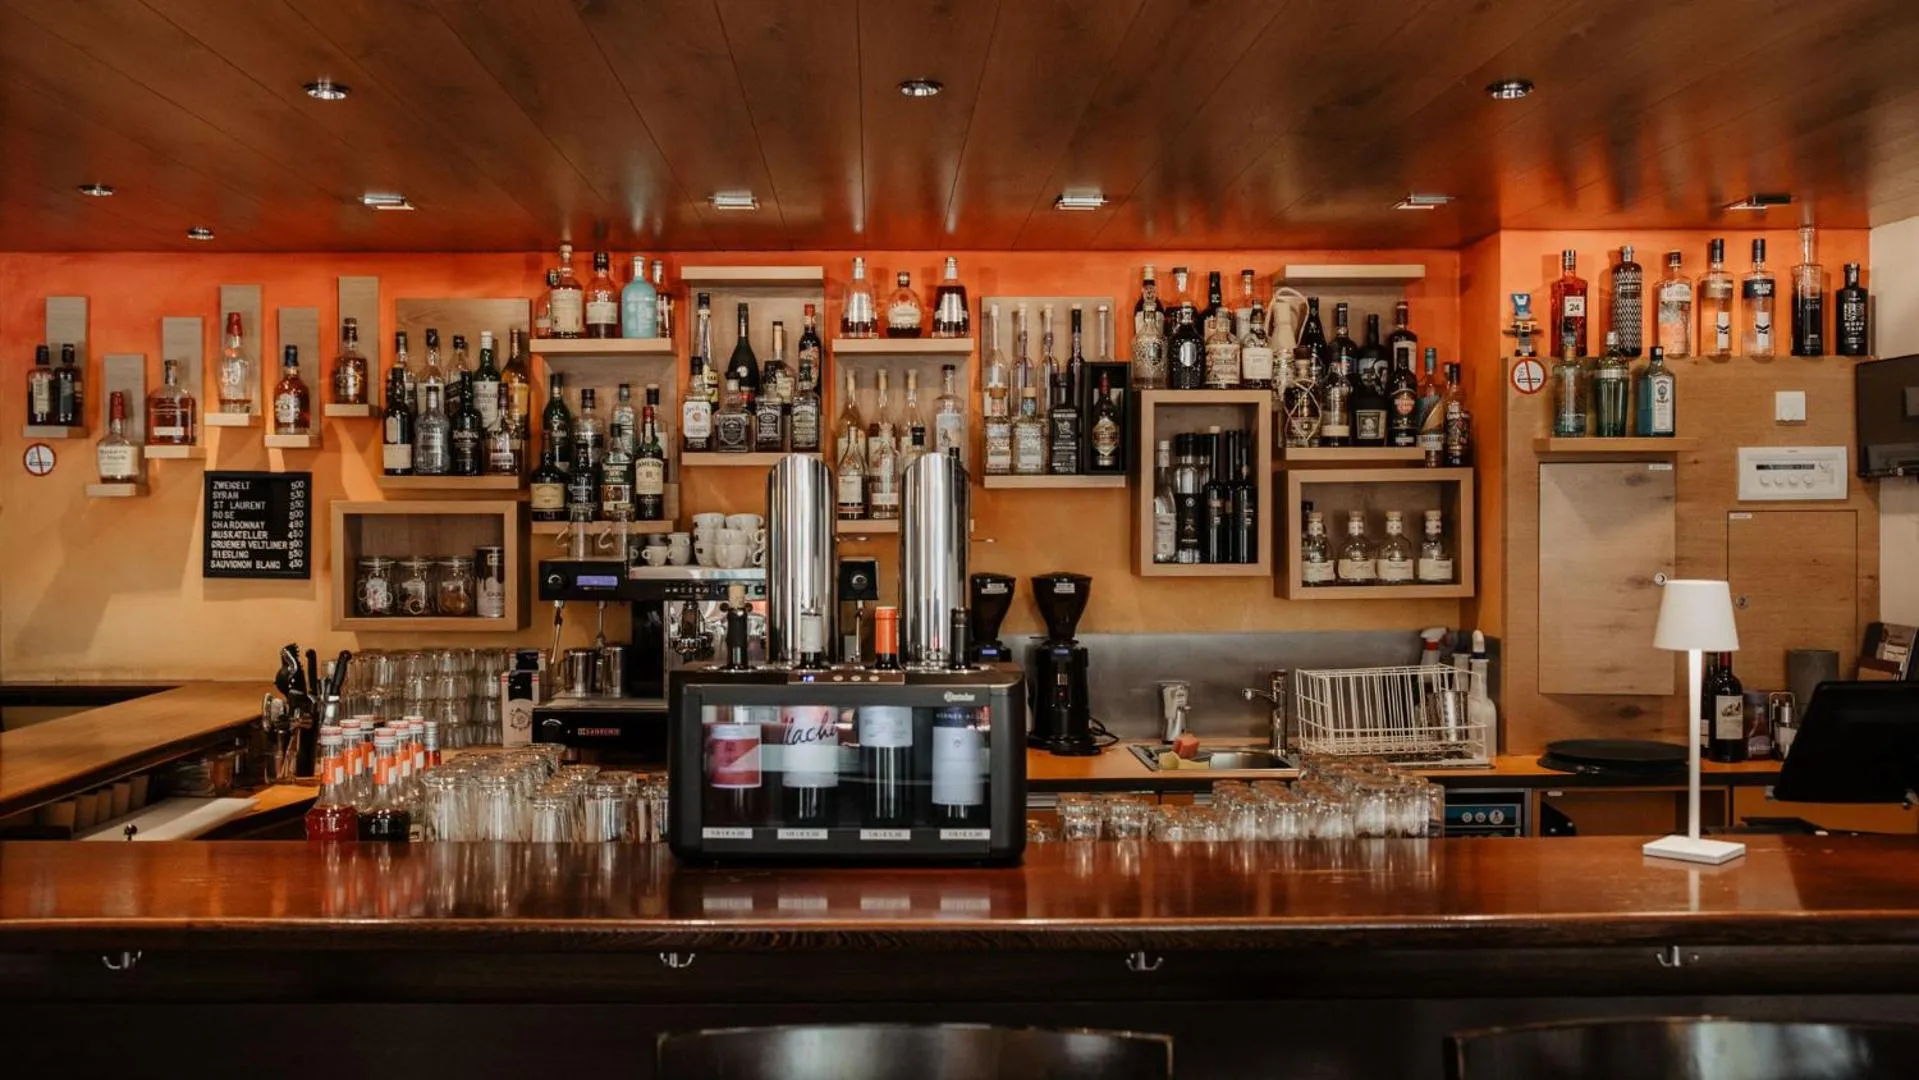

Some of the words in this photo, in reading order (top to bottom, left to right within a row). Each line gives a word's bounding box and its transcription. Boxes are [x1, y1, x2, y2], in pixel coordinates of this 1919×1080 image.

[1568, 303, 1580, 311] 24
[213, 481, 250, 490] ZWEIGELT
[212, 490, 239, 500] SYRAH
[213, 501, 224, 510] ST
[229, 501, 266, 510] LAURENT
[212, 511, 235, 519] ROSE
[212, 521, 265, 530] CHARDONNAY
[211, 530, 268, 539] MUSKATELLER
[211, 540, 246, 549] GRUENER
[248, 541, 288, 550] VELTLINER
[212, 550, 249, 559] RIESLING
[210, 560, 252, 569] SAUVIGNON
